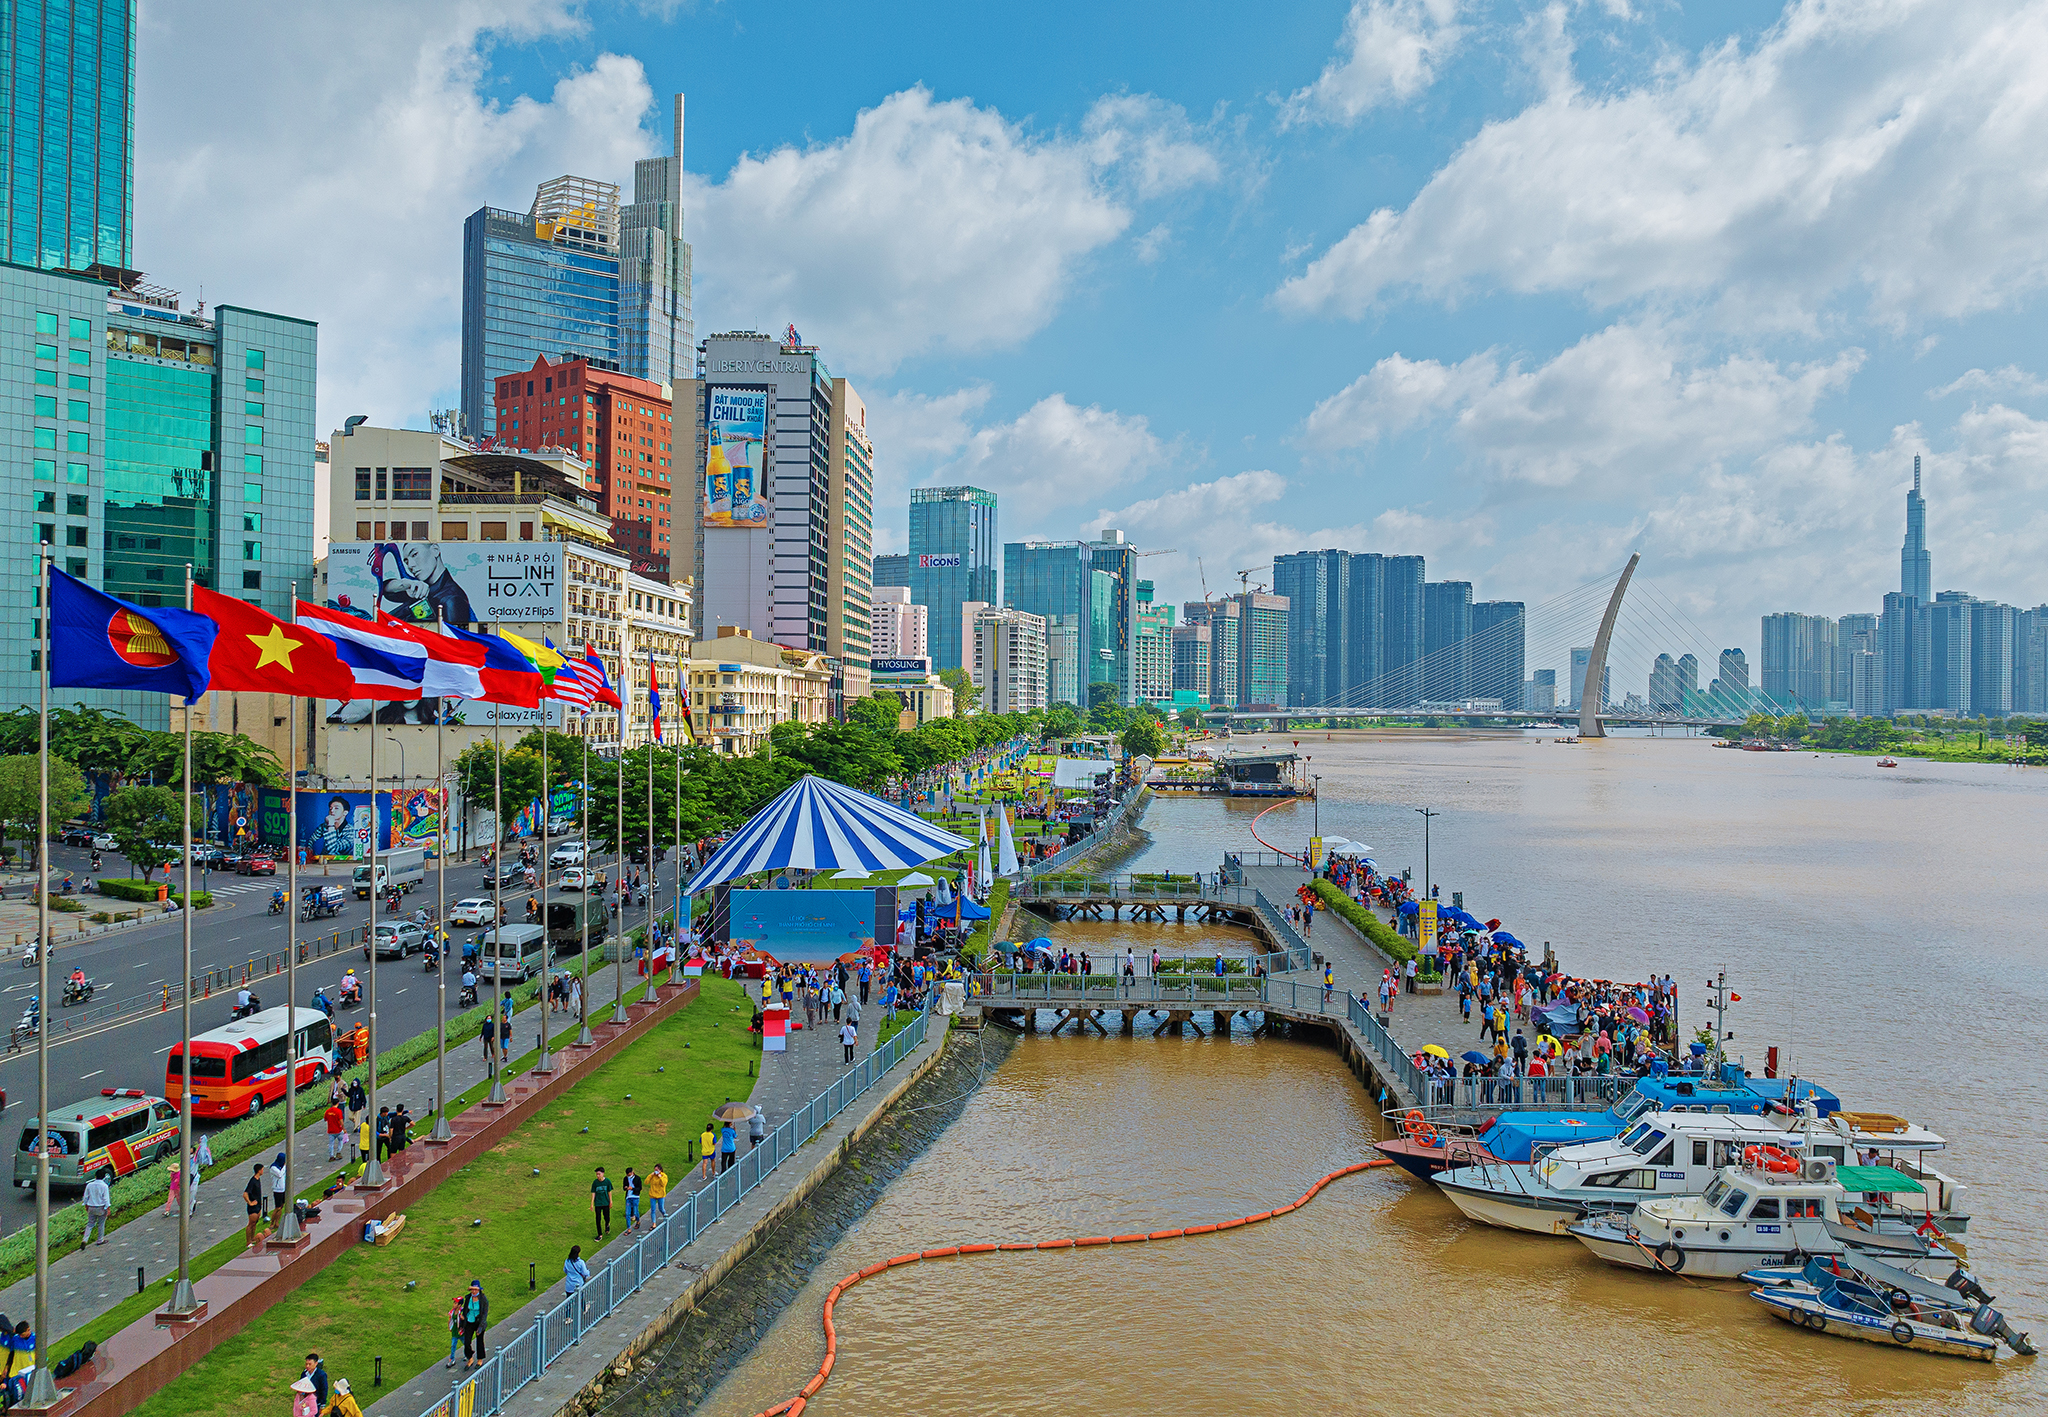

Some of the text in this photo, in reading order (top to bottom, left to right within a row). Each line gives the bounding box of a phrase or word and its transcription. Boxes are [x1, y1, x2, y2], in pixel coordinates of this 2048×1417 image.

[714, 394, 729, 406] BẬT
[730, 395, 753, 407] MOOD
[713, 405, 746, 422] CHILL
[534, 553, 555, 565] HỘI
[488, 565, 554, 580] LINH
[488, 606, 555, 618] Galaxy Z Flip5
[877, 660, 919, 669] HYOSUNG
[523, 711, 530, 720] Z
[264, 811, 297, 836] SOJ
[133, 1131, 172, 1151] AMBULANCE
